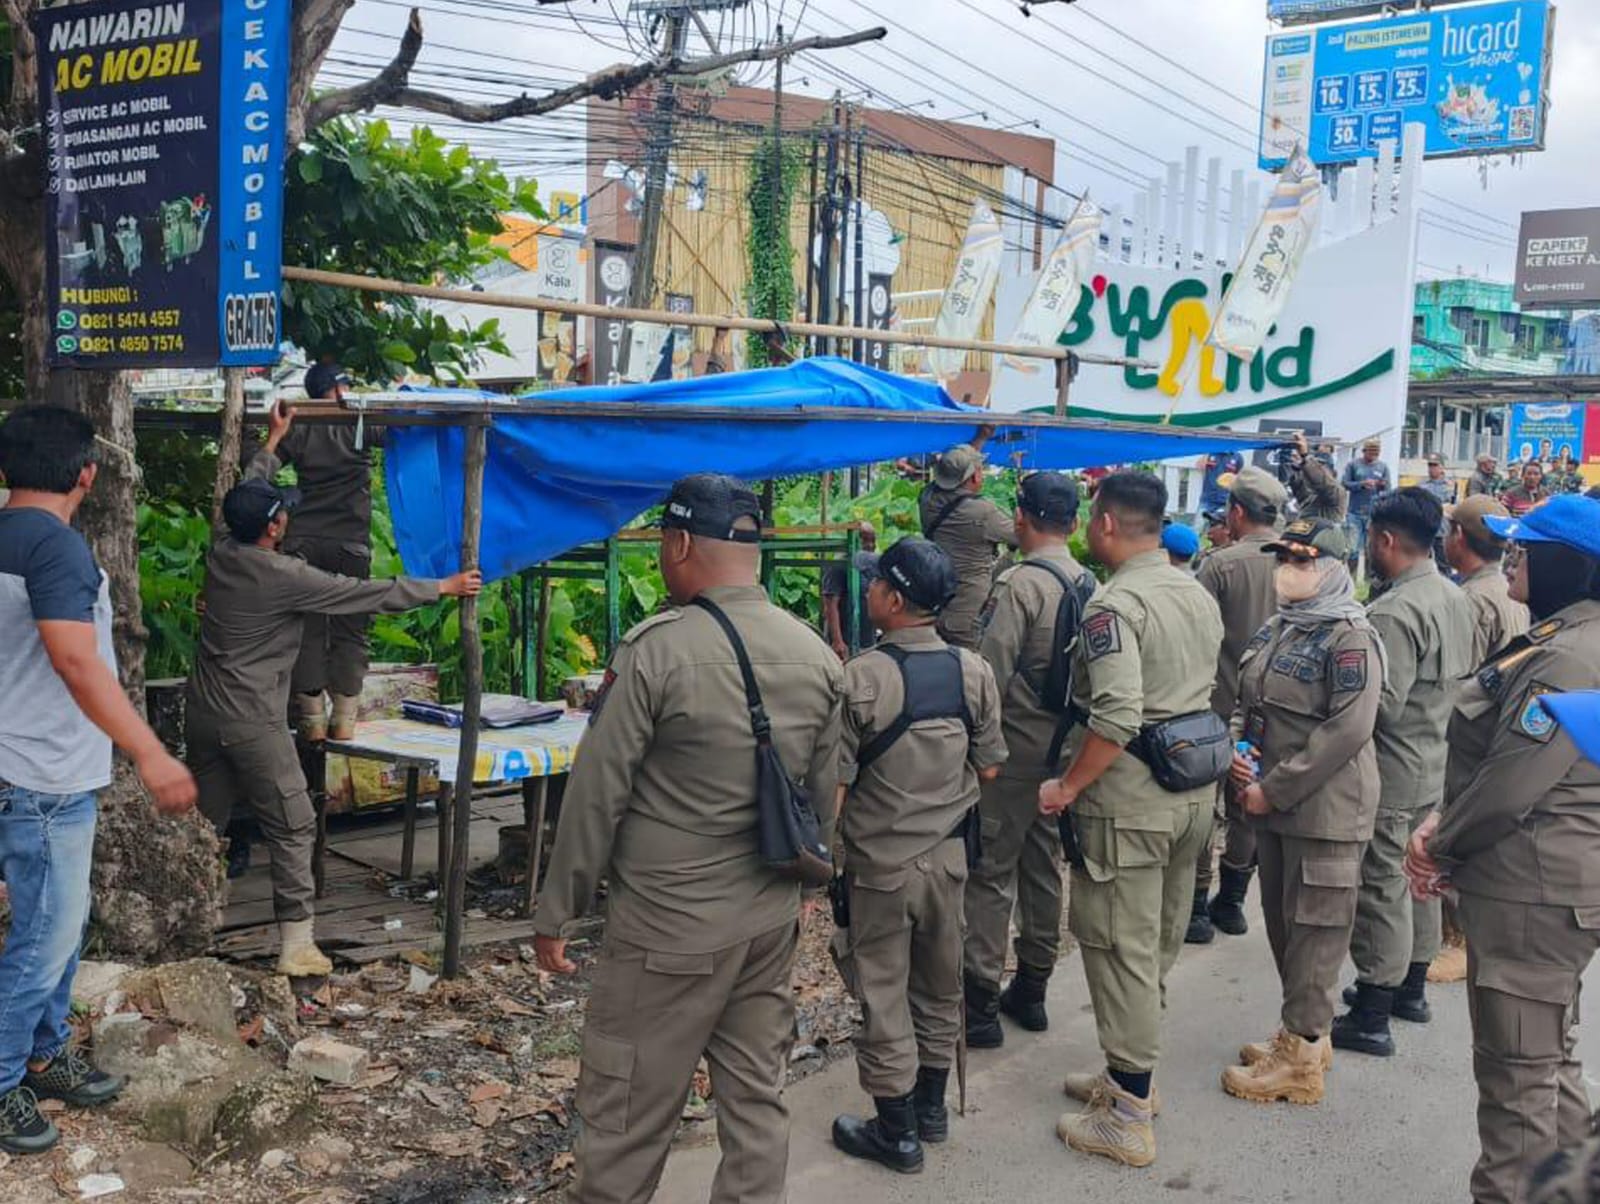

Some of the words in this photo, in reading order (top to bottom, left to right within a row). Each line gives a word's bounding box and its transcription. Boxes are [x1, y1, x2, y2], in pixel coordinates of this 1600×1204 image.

[49, 2, 185, 52] NAWARIN
[1442, 8, 1521, 57] hicard
[54, 54, 94, 93] AC
[100, 39, 202, 85] MOBIL
[111, 101, 127, 117] AC
[130, 95, 171, 115] MOBIL
[143, 120, 160, 136] AC
[164, 115, 207, 134] MOBIL
[121, 144, 160, 162] MOBIL
[1547, 254, 1584, 267] NEST
[545, 273, 571, 288] Kala
[60, 286, 131, 304] HUBUNGI
[79, 313, 113, 329] 0821
[117, 312, 147, 328] 5474
[150, 309, 180, 327] 4557
[225, 292, 276, 351] GRATIS
[79, 336, 115, 352] 0821
[152, 334, 184, 351] 7574
